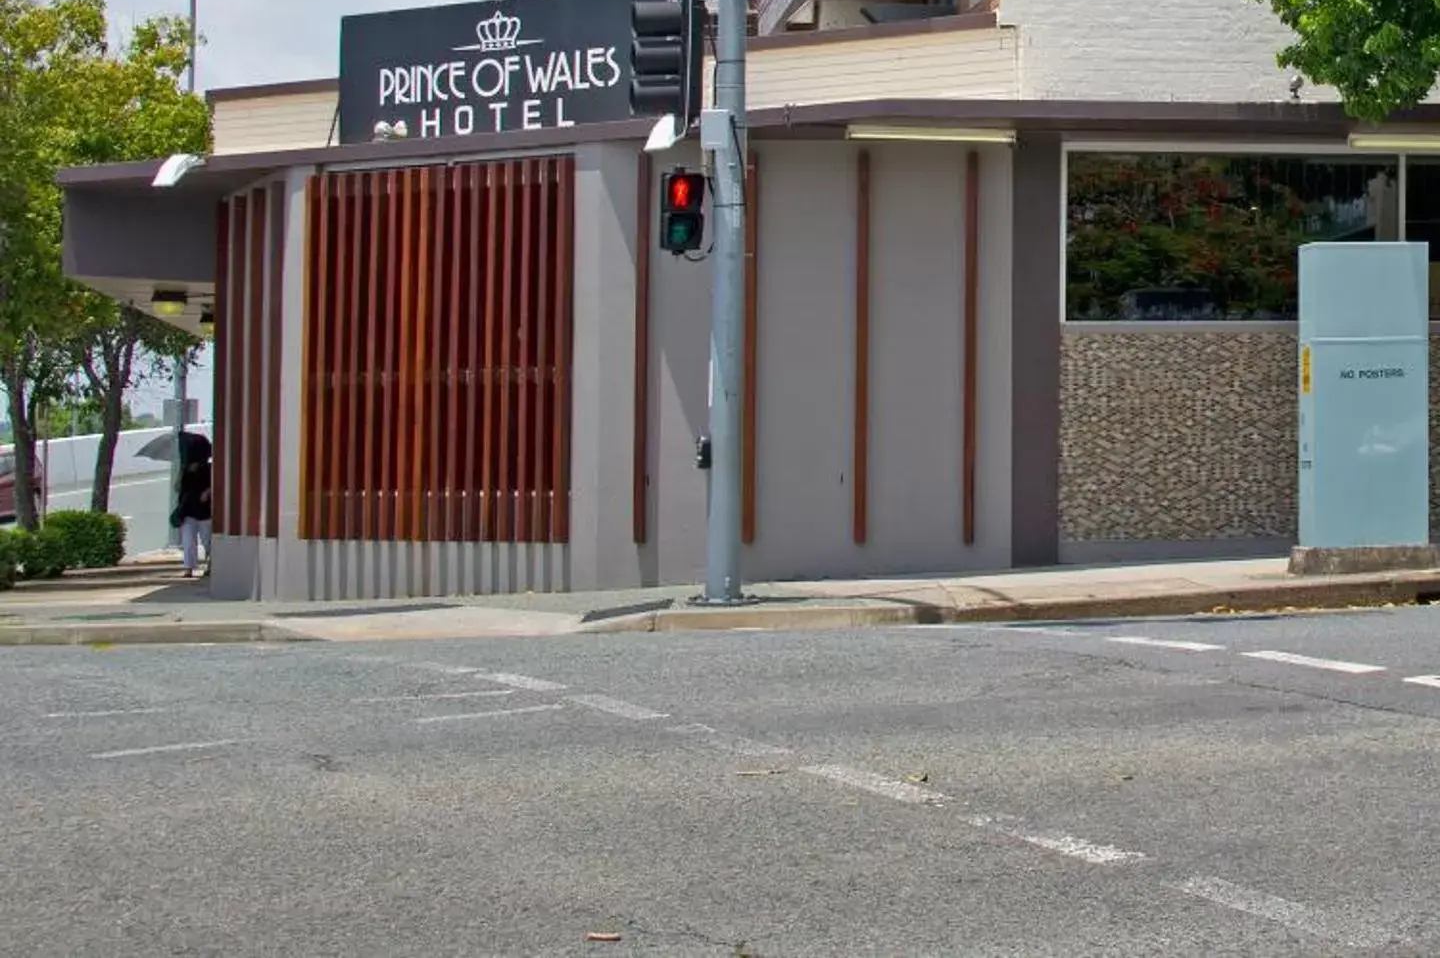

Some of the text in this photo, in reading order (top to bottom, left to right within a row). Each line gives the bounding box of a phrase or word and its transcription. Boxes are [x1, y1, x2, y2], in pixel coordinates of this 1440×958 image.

[379, 46, 621, 105] PRINCE OF WALES
[420, 97, 575, 138] HOTEL
[1340, 369, 1354, 379] NO
